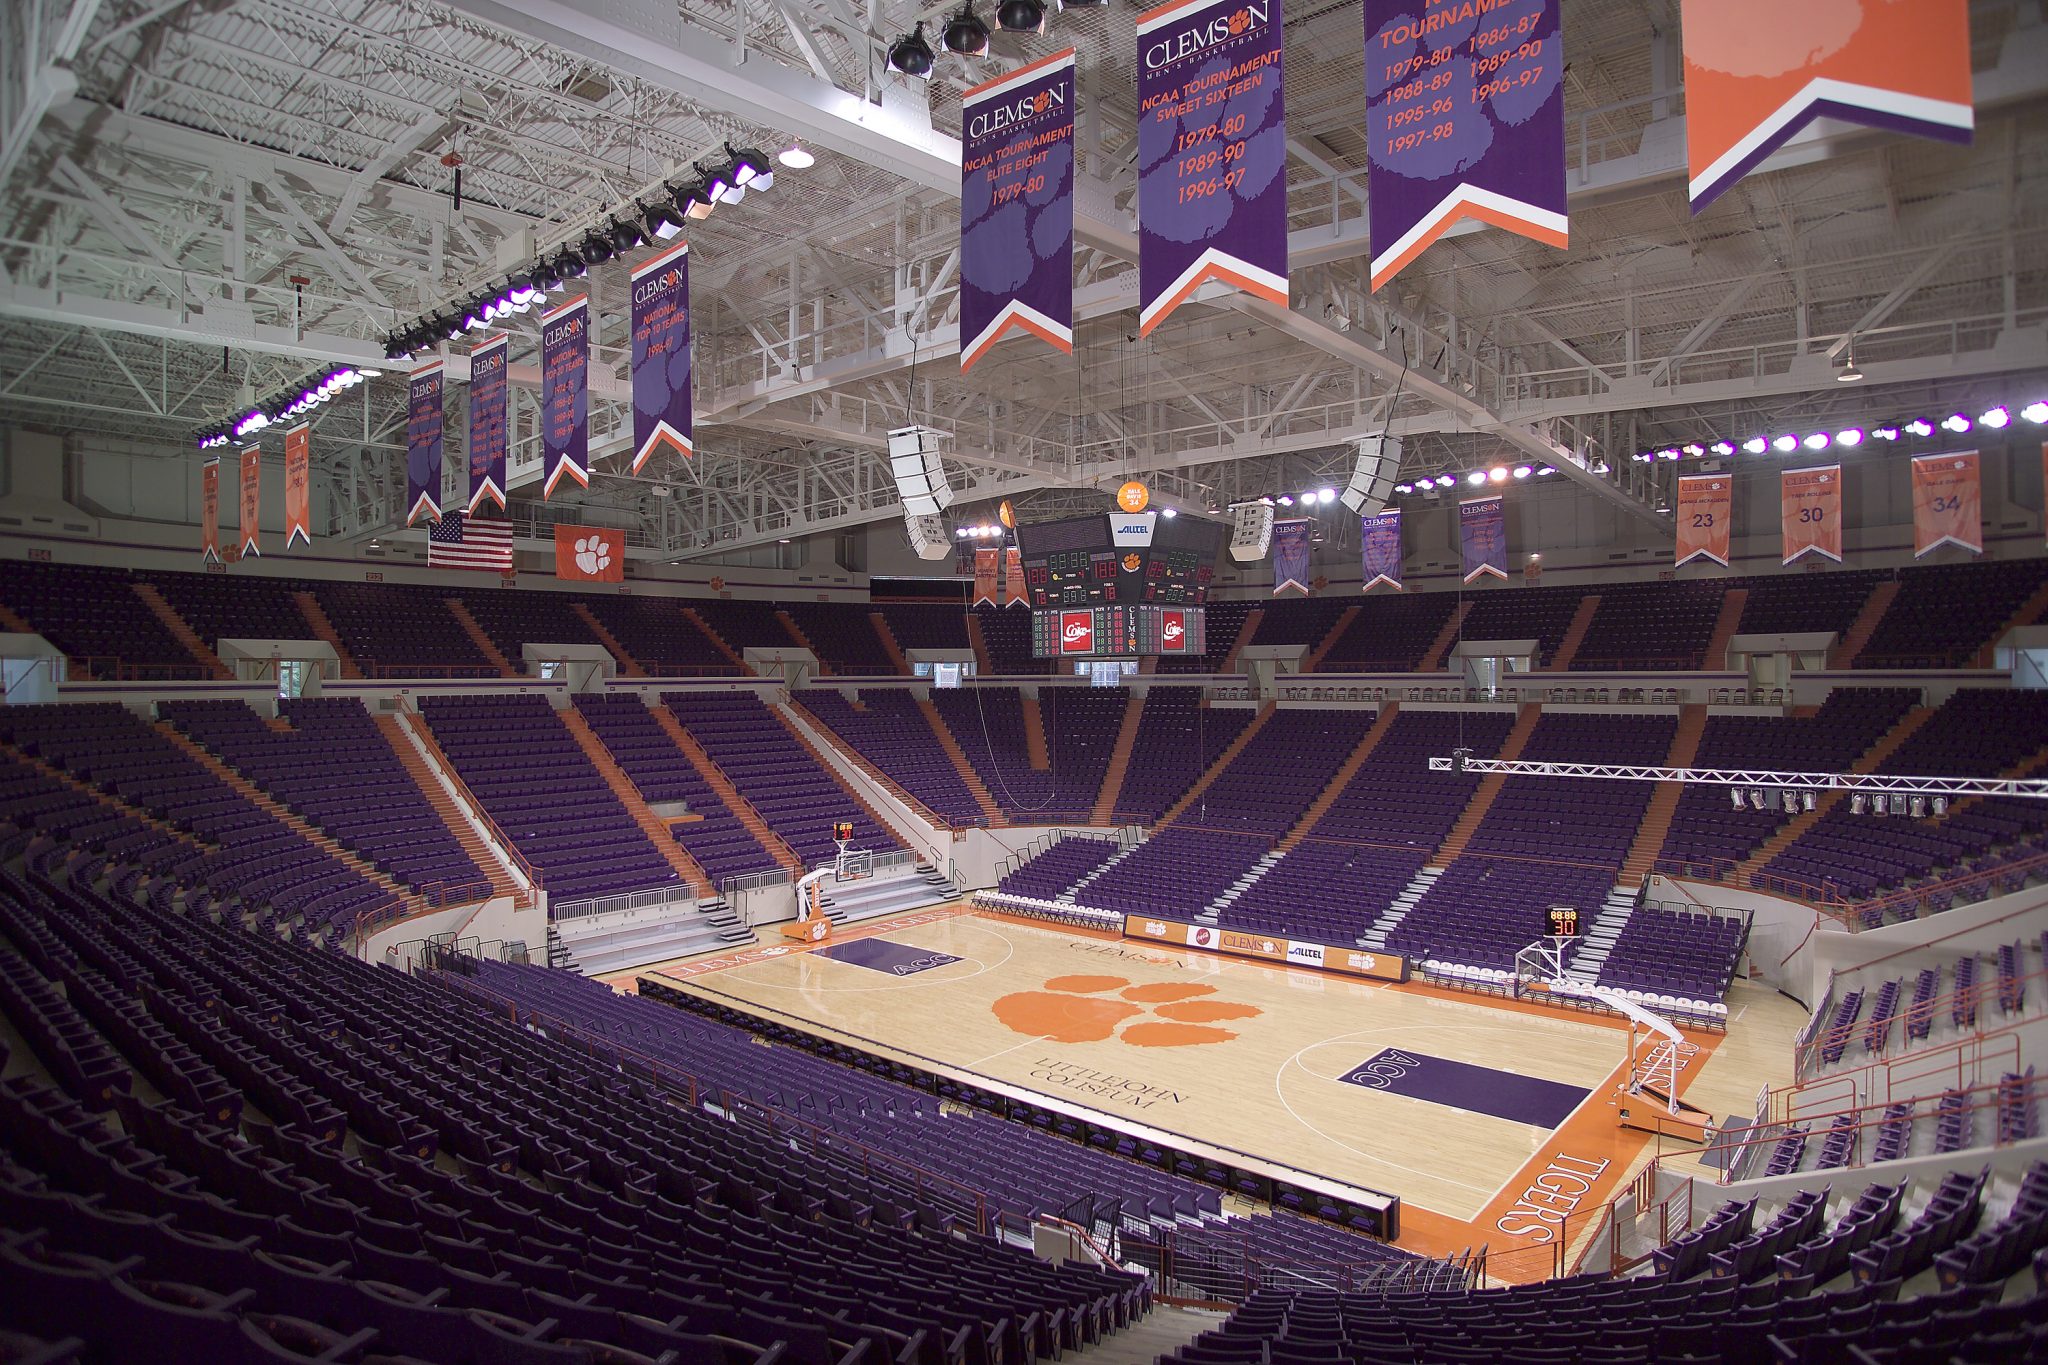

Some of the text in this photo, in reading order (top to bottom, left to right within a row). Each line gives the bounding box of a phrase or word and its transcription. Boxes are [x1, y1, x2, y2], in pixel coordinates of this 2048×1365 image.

[1146, 0, 1268, 68] CLEMSON
[1380, 0, 1516, 49] TOURNAM
[1469, 12, 1541, 53] 1986-87
[1147, 29, 1269, 80] MEN'S BASKETBALL
[1385, 46, 1451, 81] 1979-80
[1470, 40, 1542, 78] 1989-90
[1142, 49, 1281, 112] NCAA TOURNAMENT
[1386, 71, 1452, 105] 1988-89
[1471, 67, 1543, 104] 1996-97
[969, 82, 1065, 138] CLEMSON
[1156, 74, 1263, 123] SWEET SIXTEEN
[1387, 96, 1453, 130] 1995-96
[1003, 109, 1065, 136] BASKETBALL
[1178, 114, 1245, 151] 1979-80
[1388, 122, 1453, 155] 1997-98
[964, 124, 1074, 172] NCAA TOURNAMENT
[1178, 141, 1246, 178] 1989-90
[987, 151, 1049, 181] ELITE EIGHT
[993, 175, 1045, 205] 1979-80
[1178, 167, 1246, 204] 1996-97
[636, 327, 651, 342] TOP
[662, 311, 686, 331] TEAMS
[643, 301, 677, 326] NATIONAL
[551, 347, 578, 367] NATIONAL
[648, 336, 674, 358] 1996-97
[565, 356, 584, 373] TEAMS
[1693, 514, 1713, 527] 23
[1800, 507, 1823, 523] 30
[1933, 496, 1960, 512] 34
[1118, 525, 1148, 534] ALLTEL
[1066, 624, 1088, 636] Coke
[1166, 622, 1182, 635] Coke
[865, 911, 955, 931] TIGERS
[1551, 911, 1577, 920] 88:88
[1555, 920, 1574, 935] 30
[1224, 935, 1283, 954] CLEMSON
[1288, 948, 1322, 959] ALLTEL
[893, 954, 955, 976] ACC
[1035, 1057, 1191, 1104] LITTLEJOHN
[1352, 1050, 1420, 1088] ACC
[1030, 1070, 1156, 1109] COLISEUM
[1497, 1152, 1612, 1242] TIGERS
